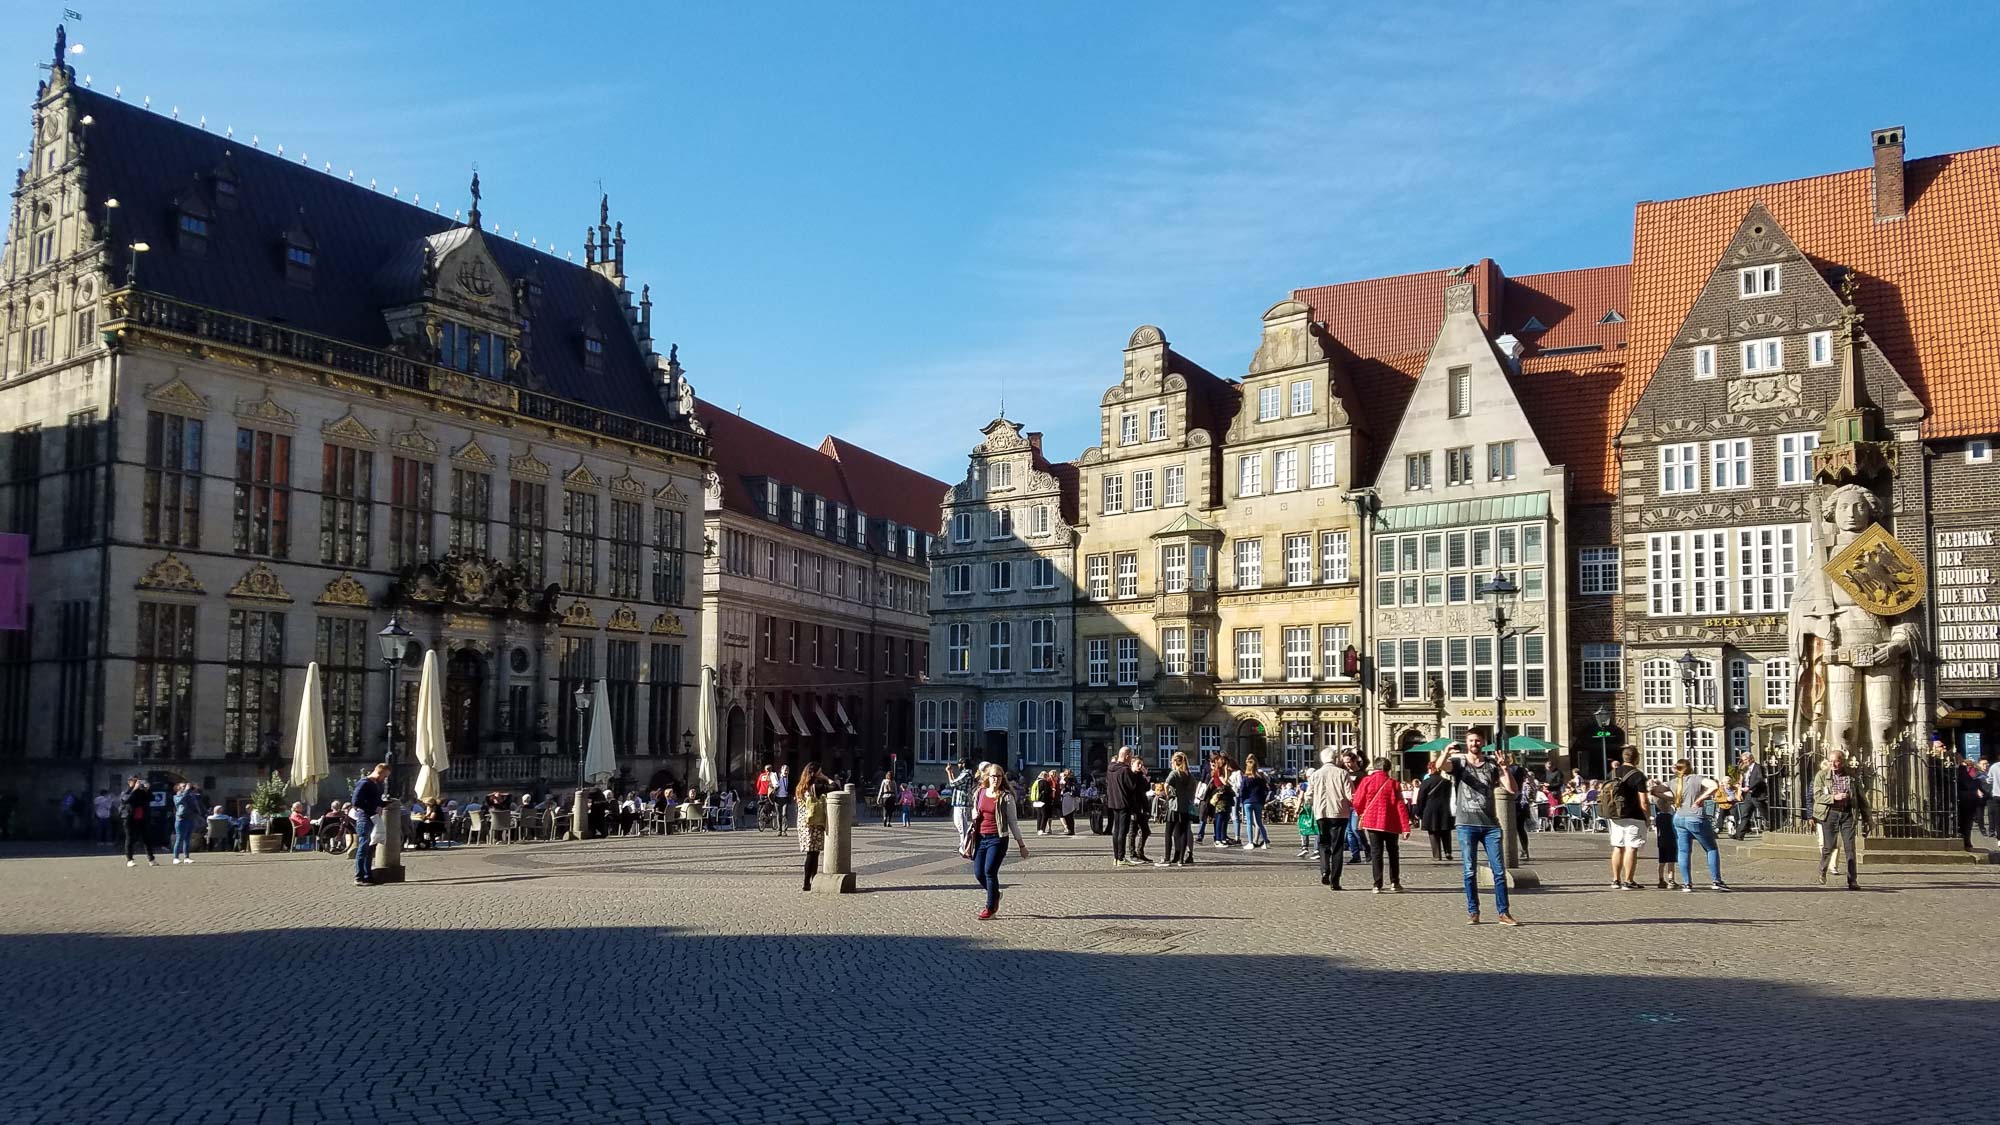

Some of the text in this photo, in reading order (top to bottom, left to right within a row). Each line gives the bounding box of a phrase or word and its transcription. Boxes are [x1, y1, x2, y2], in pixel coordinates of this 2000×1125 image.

[1937, 530, 1995, 548] GEDENKE
[1937, 551, 1963, 567] DER
[1938, 567, 1996, 585] BRÜDER,
[1939, 588, 1960, 604] DIE
[1963, 588, 1987, 603] DAS
[1940, 624, 1998, 641] UNSERER
[1229, 694, 1349, 706] RATHS APOTHEKE
[1503, 708, 1536, 717] ISTRO
